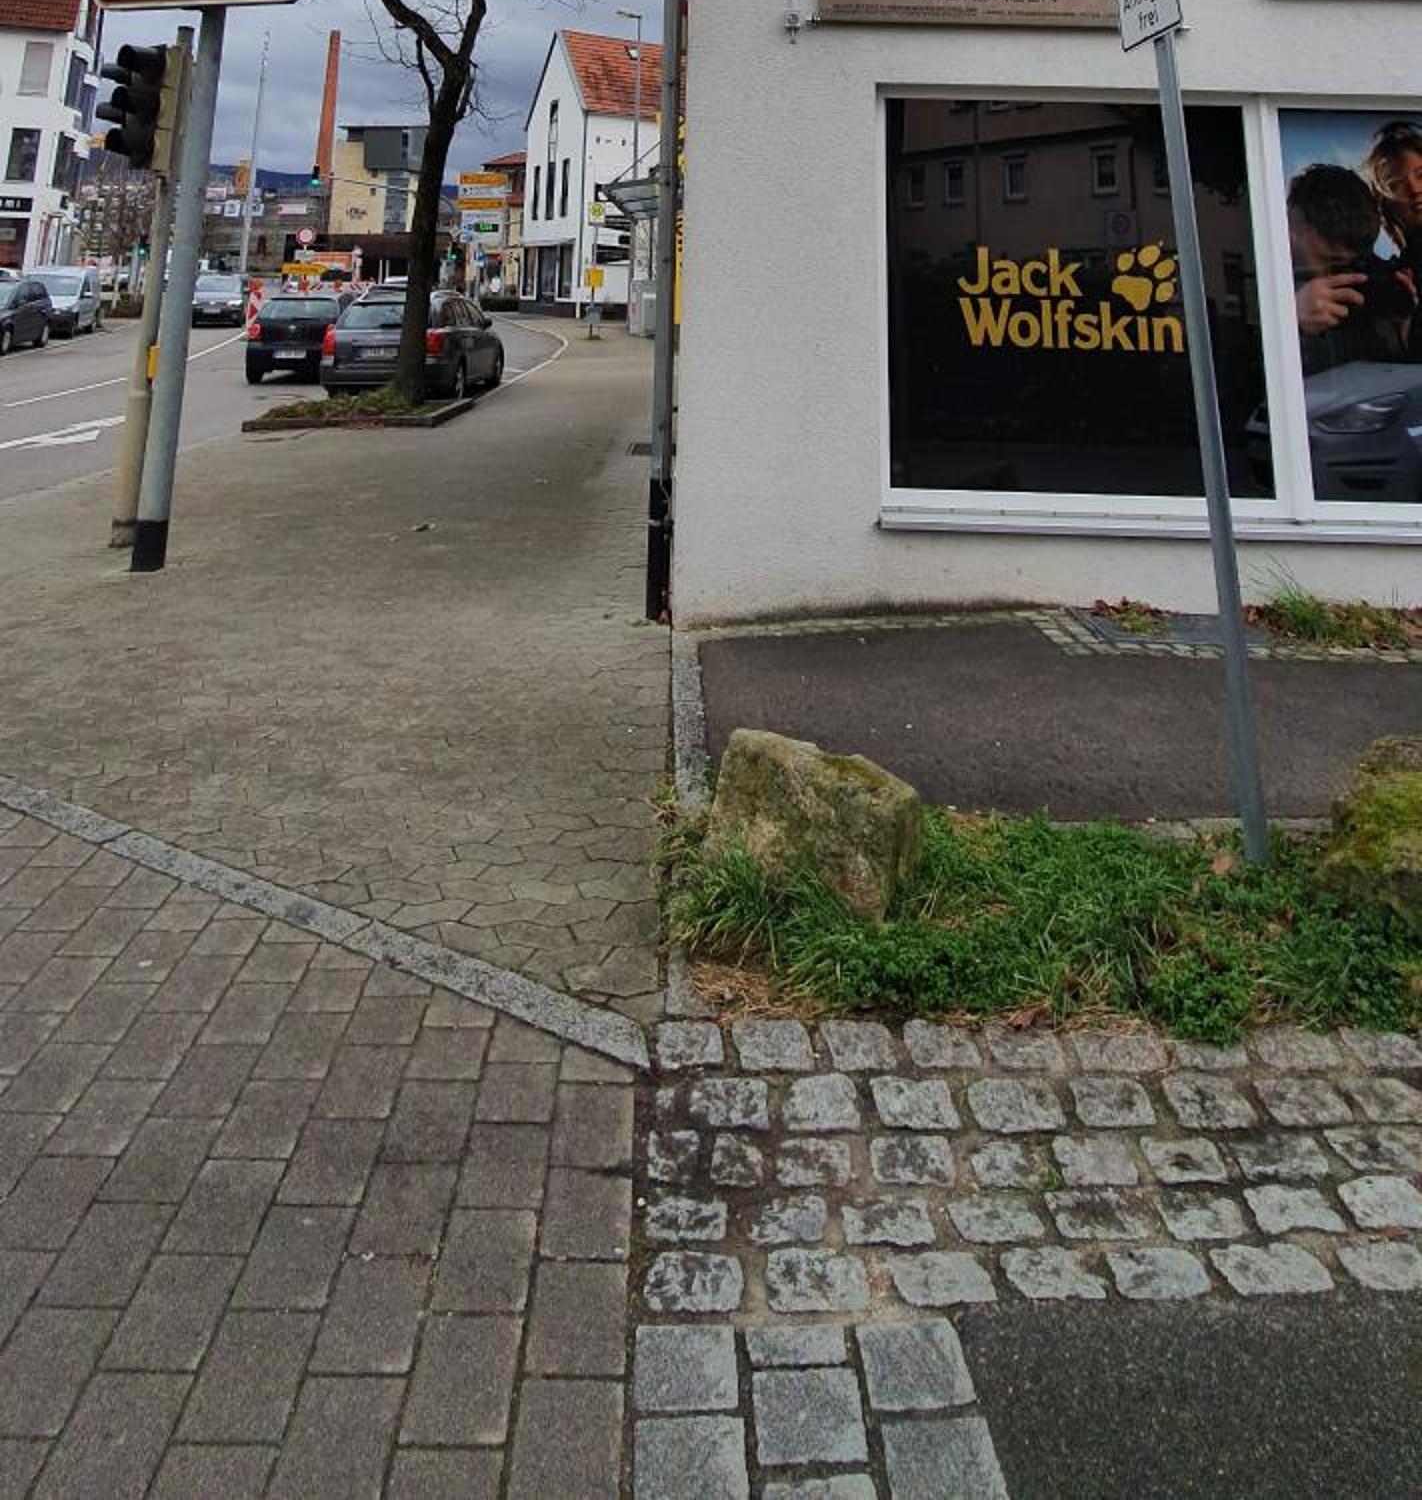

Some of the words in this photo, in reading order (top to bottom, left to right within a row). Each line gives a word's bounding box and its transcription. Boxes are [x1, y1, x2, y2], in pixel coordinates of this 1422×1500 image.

[1138, 3, 1160, 30] frei
[957, 245, 1083, 297] Jack
[959, 296, 1184, 353] Wolfskin
